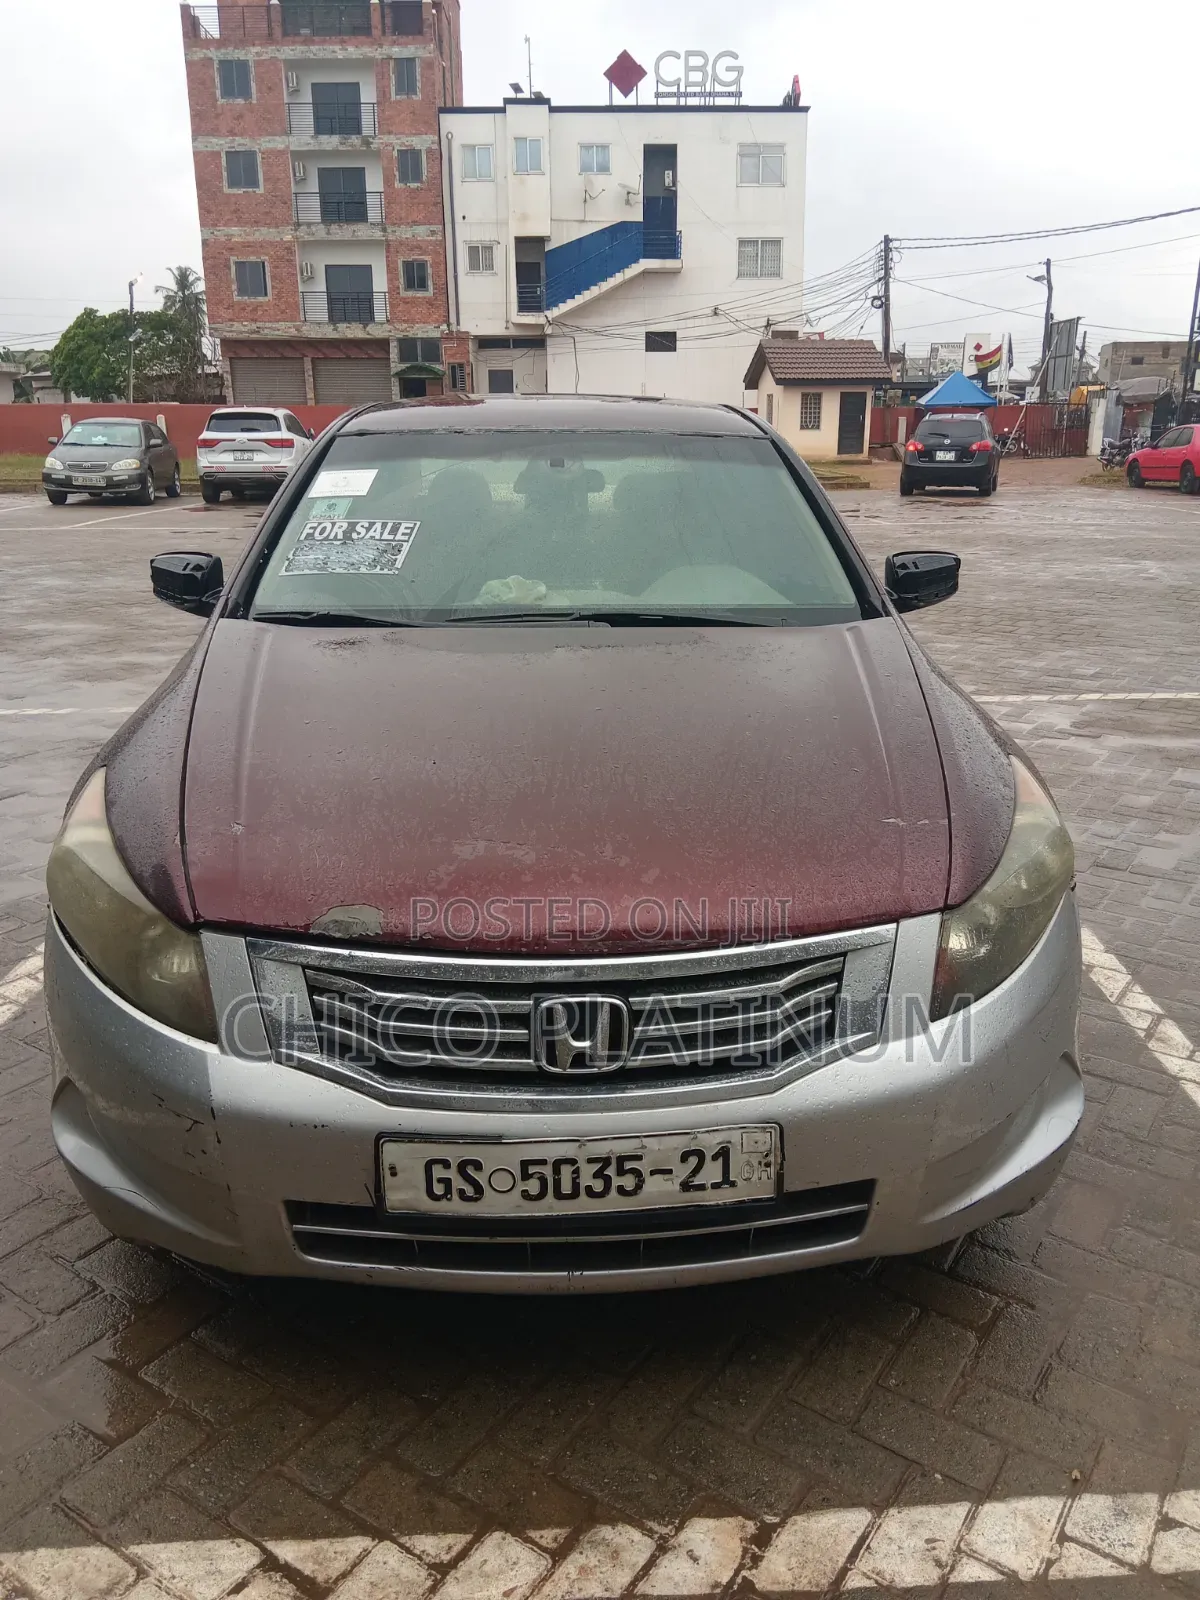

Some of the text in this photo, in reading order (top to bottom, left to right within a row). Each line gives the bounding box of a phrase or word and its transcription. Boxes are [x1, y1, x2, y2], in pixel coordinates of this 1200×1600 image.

[654, 50, 744, 87] CBG
[298, 521, 415, 540] FOR SALE
[423, 1144, 739, 1203] GS 5035-21
[741, 1160, 773, 1181] GH
